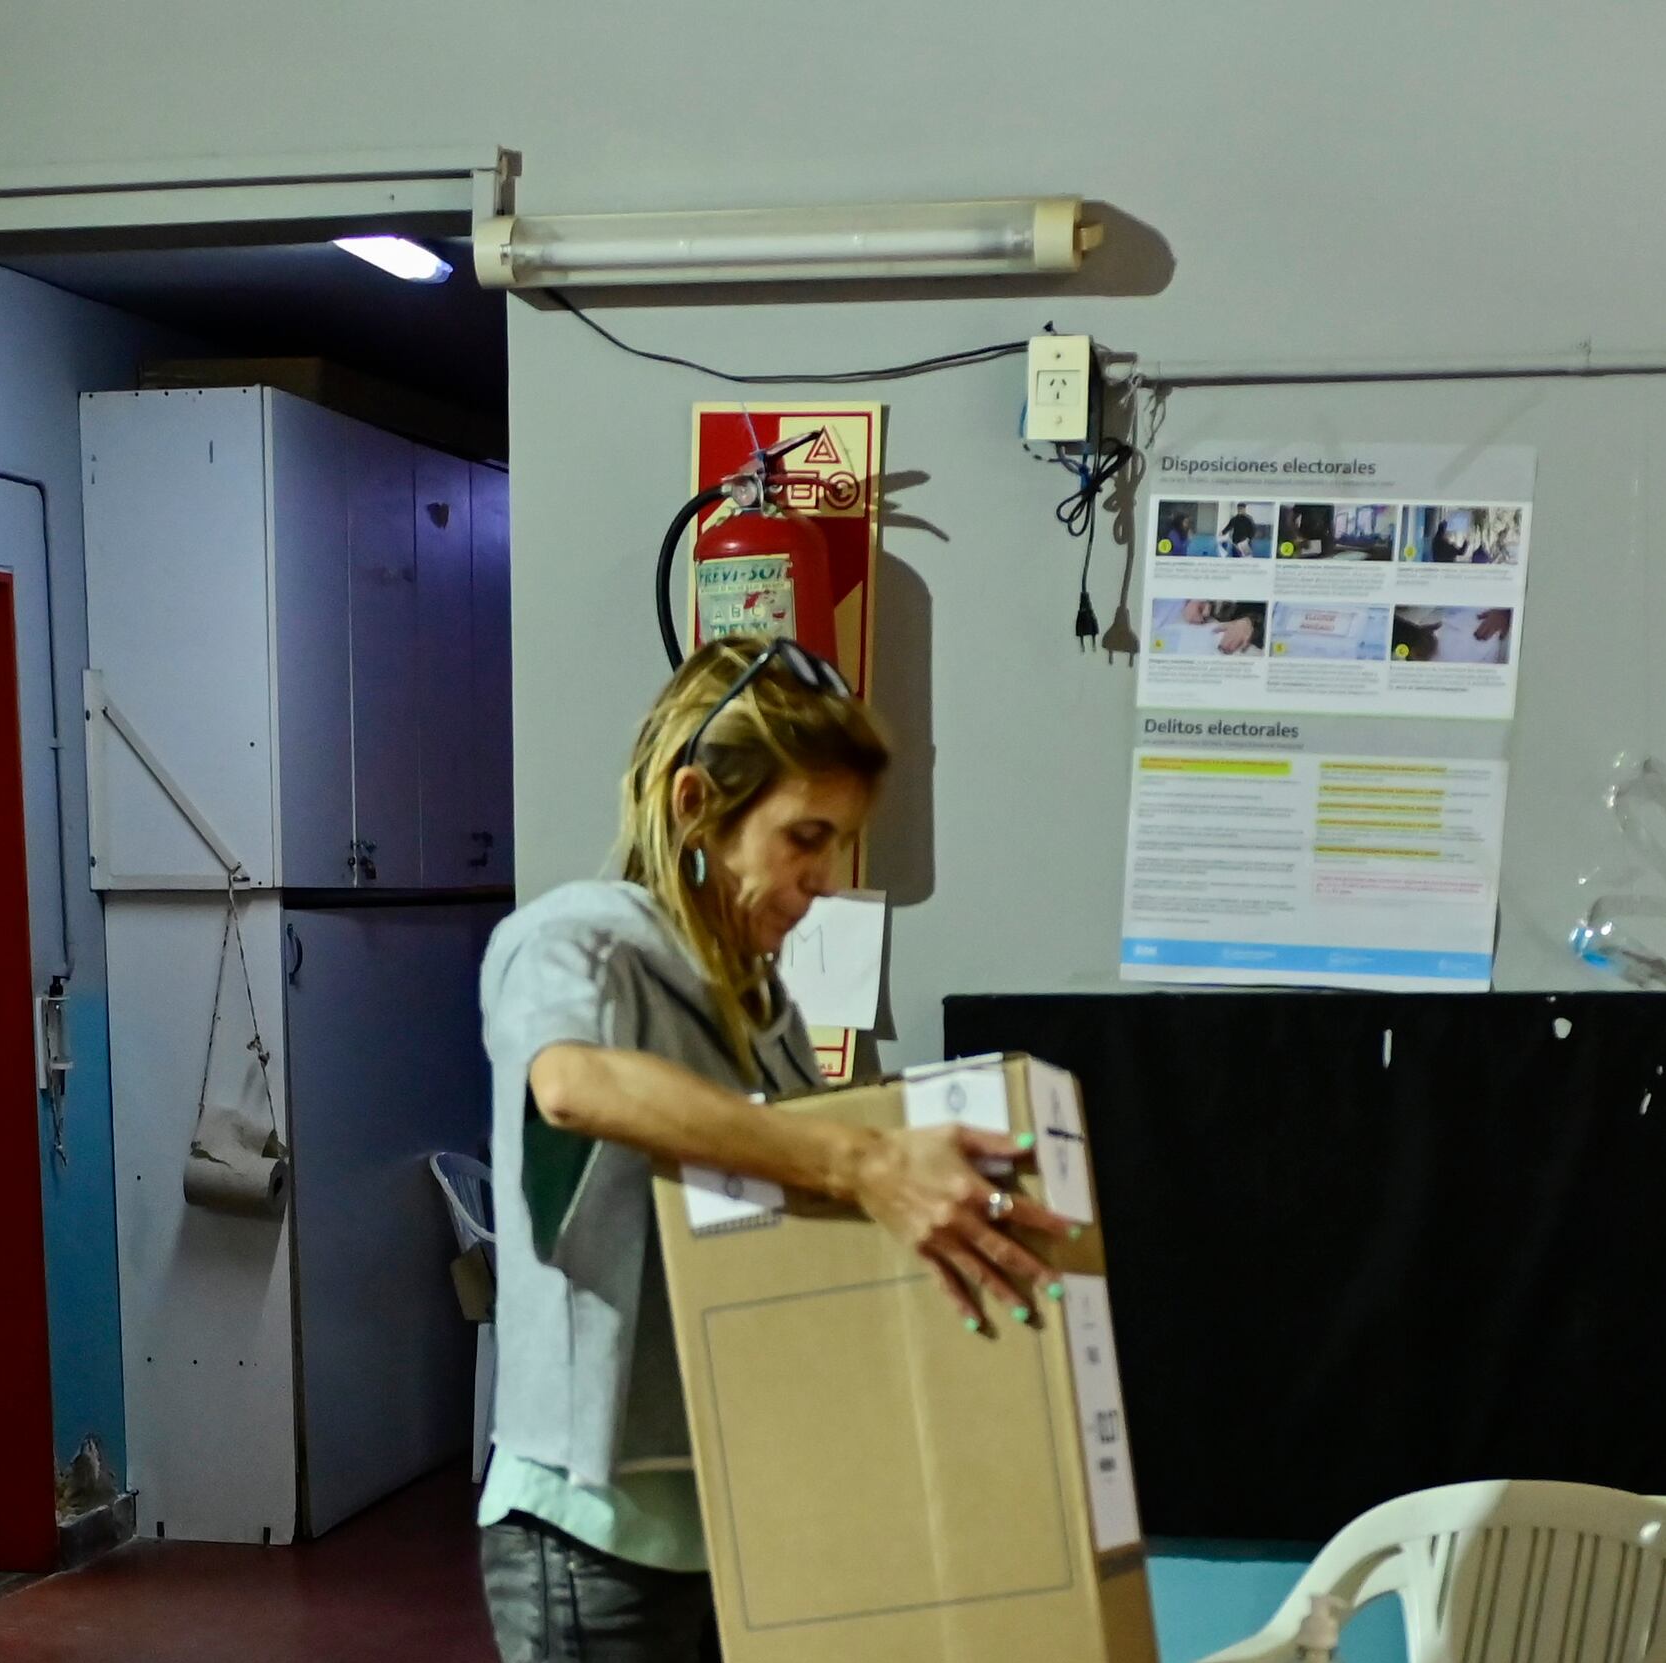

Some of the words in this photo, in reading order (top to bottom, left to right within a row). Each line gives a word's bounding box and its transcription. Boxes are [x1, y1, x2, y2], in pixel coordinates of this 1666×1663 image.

[1160, 456, 1279, 476] Disposiciones
[1282, 457, 1377, 476] electorales
[1144, 718, 1204, 736] Delitos
[1207, 720, 1300, 739] electorales
